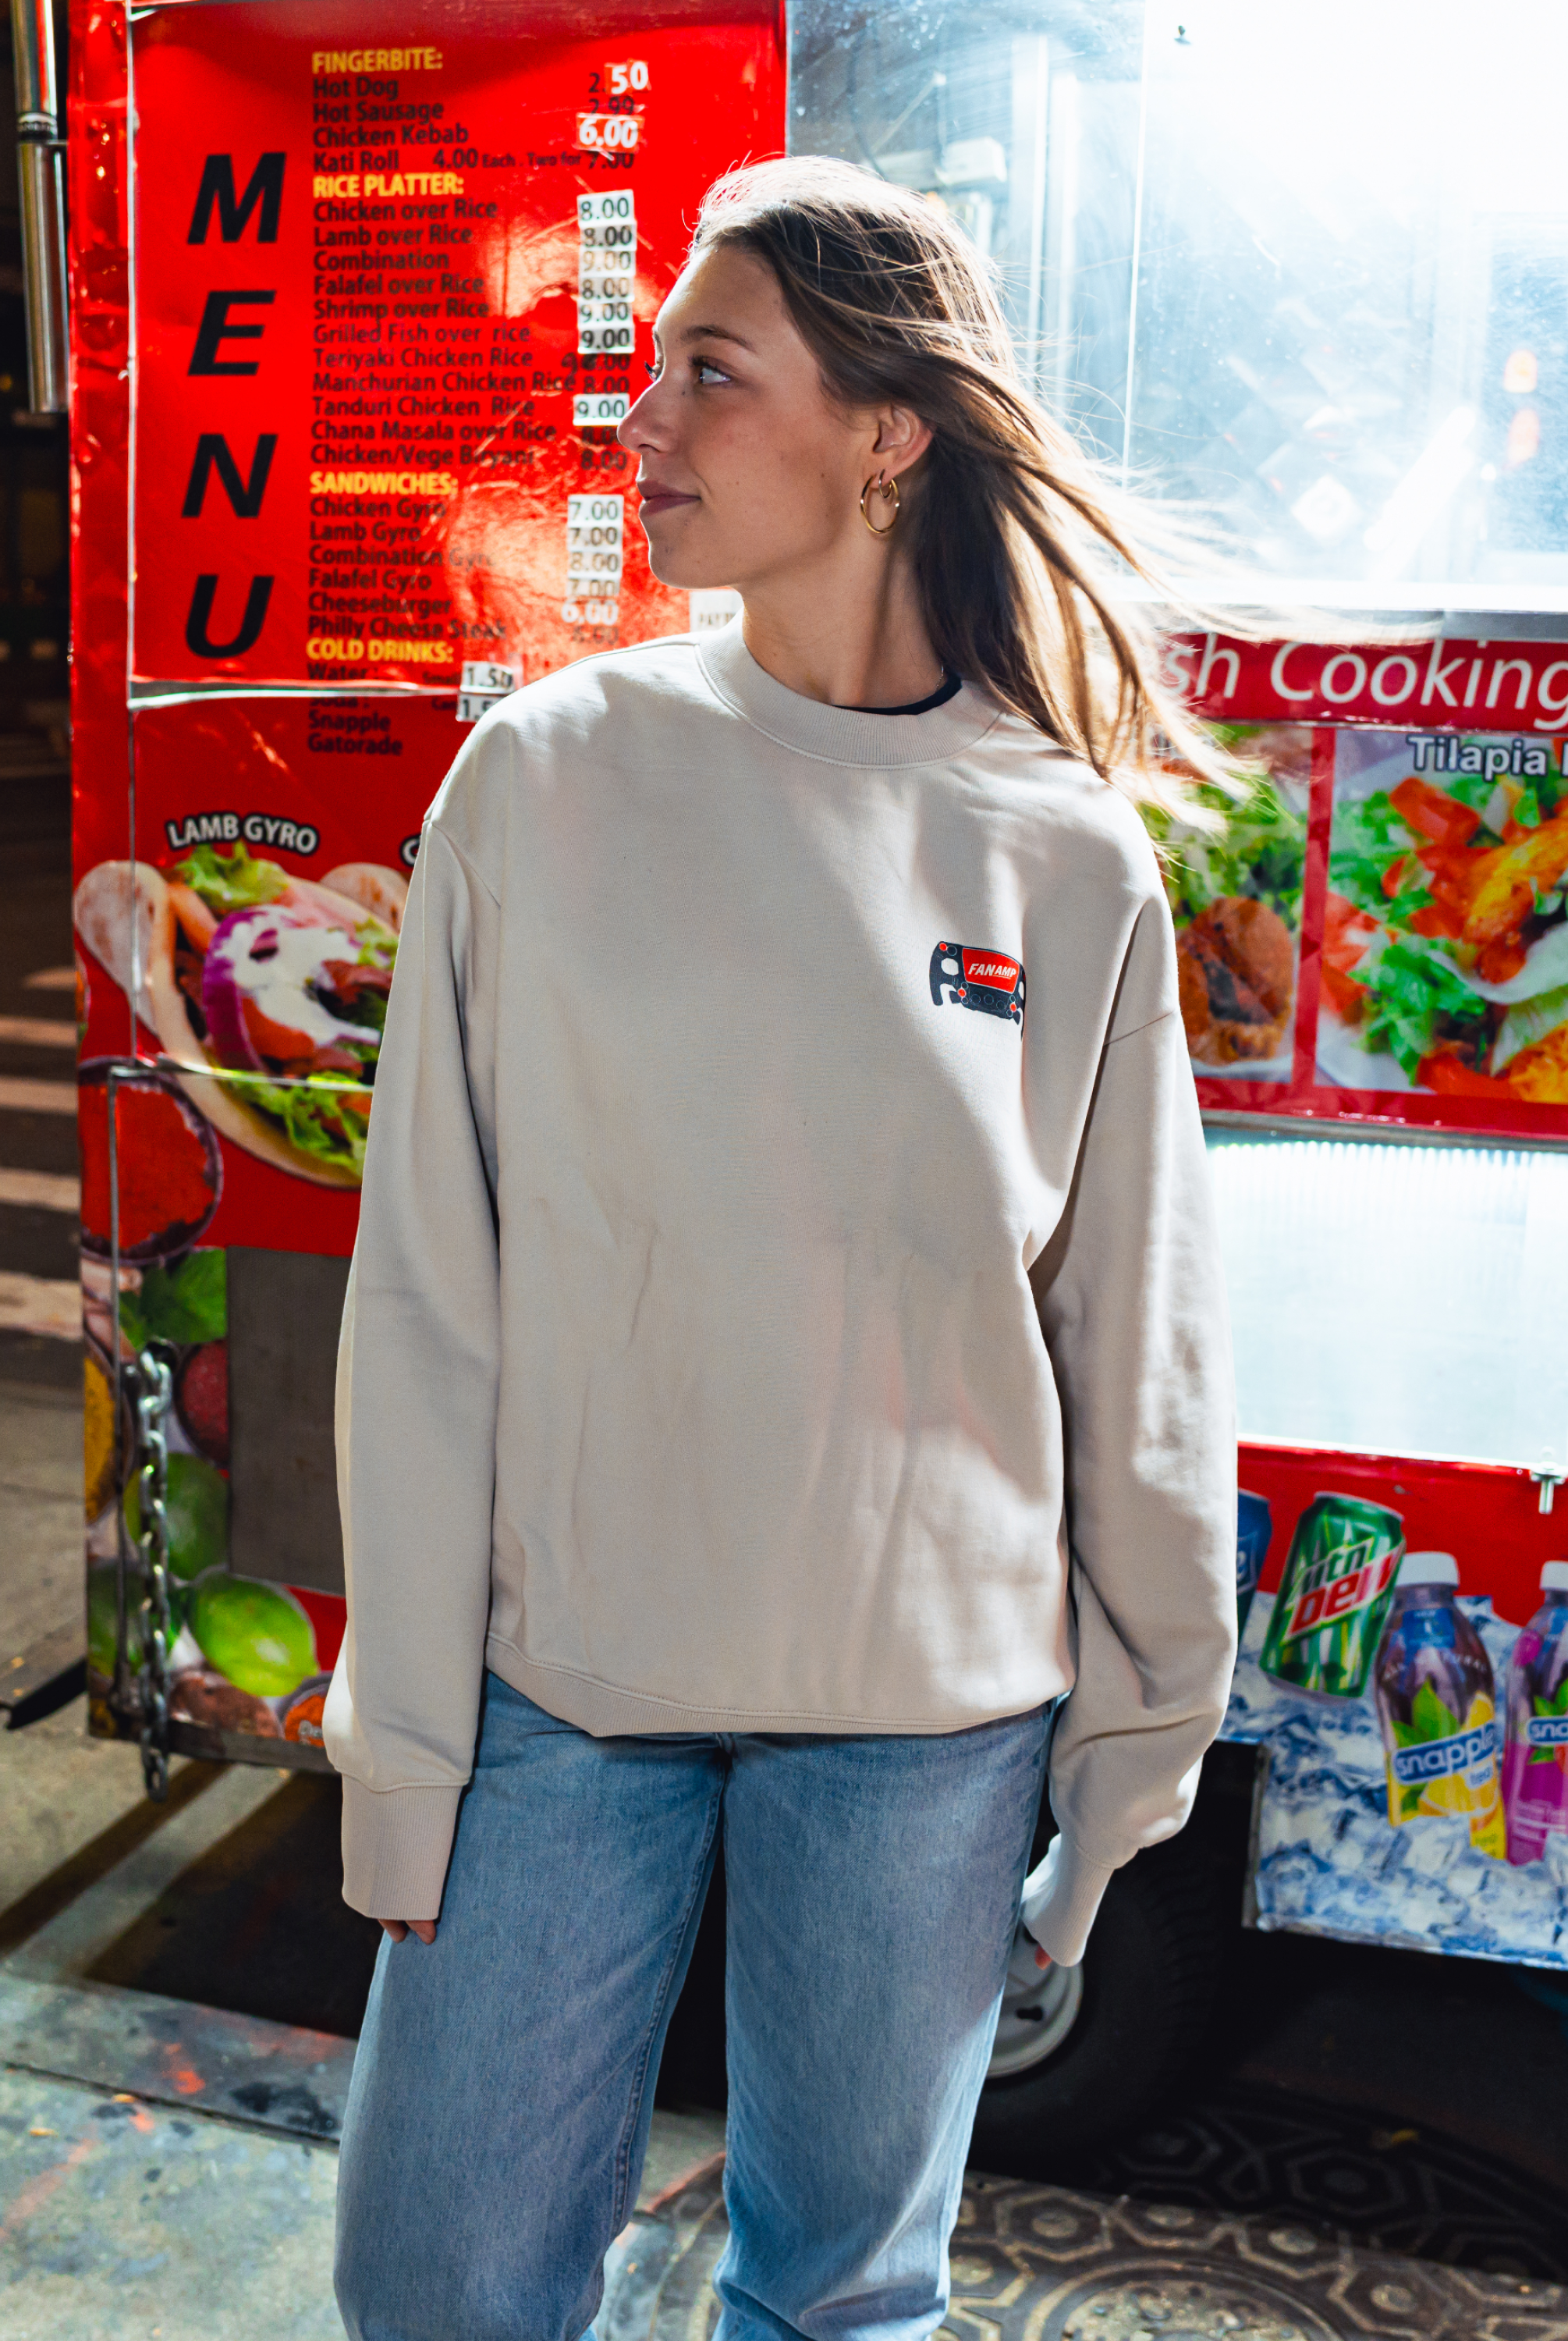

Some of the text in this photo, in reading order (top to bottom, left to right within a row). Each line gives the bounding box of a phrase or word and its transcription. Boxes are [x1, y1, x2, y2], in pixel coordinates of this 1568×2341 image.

[312, 45, 443, 73] FINGERBITE:
[313, 77, 349, 98] Hot
[356, 76, 398, 101] Dog
[313, 103, 349, 123] Hot
[356, 101, 444, 125] Sausage
[313, 118, 638, 148] Chicken Kebab 6.00
[314, 151, 353, 172] Kati
[360, 149, 399, 171] Roll
[433, 148, 478, 169] 4.00
[483, 154, 516, 168] Each
[561, 151, 581, 166] for
[314, 172, 465, 198] RICE PLATTER:
[314, 197, 629, 222] Chicken over Rice 8.00
[314, 226, 372, 247] Lamb
[377, 229, 424, 245] over
[429, 225, 473, 243] Rice
[314, 248, 450, 271] Combination
[314, 273, 630, 300] Falafel over Rice 8.00
[314, 297, 629, 322] Shrimp over Rice 9.00
[313, 321, 630, 349] Grilled Fish over rice 9.00
[314, 347, 395, 371] Teriyaki
[400, 346, 483, 368] Chicken
[490, 346, 533, 368] Rice
[313, 371, 436, 392] Manchurian
[442, 371, 526, 392] Chicken
[533, 371, 576, 392] Rice
[313, 396, 391, 416] Tanduri
[397, 396, 481, 417] Chicken
[491, 396, 535, 416] Rice
[310, 419, 375, 440] Chana
[381, 420, 454, 440] Masala
[459, 425, 506, 440] over
[513, 420, 556, 442] Rice
[310, 443, 454, 470] Chicken/Vege
[581, 449, 627, 471] 8.00
[309, 471, 459, 495] SANDWICHES:
[310, 496, 619, 523] Chicken Gyro 7.00
[310, 520, 367, 542] Lamb
[371, 520, 421, 545] Gyro
[309, 546, 443, 567] Combination
[309, 567, 378, 589] Falafel
[382, 569, 432, 594] Gyro
[308, 591, 452, 619] Cheeseburger
[307, 615, 365, 638] Philly
[369, 617, 443, 638] Cheese
[306, 637, 454, 663] COLD DRINKS:
[308, 709, 391, 734] Snapple
[307, 732, 403, 755] Gatorade
[1407, 736, 1548, 780] Tilapia
[167, 814, 318, 854] LAMB GYRO
[968, 963, 1016, 978] FANAMP
